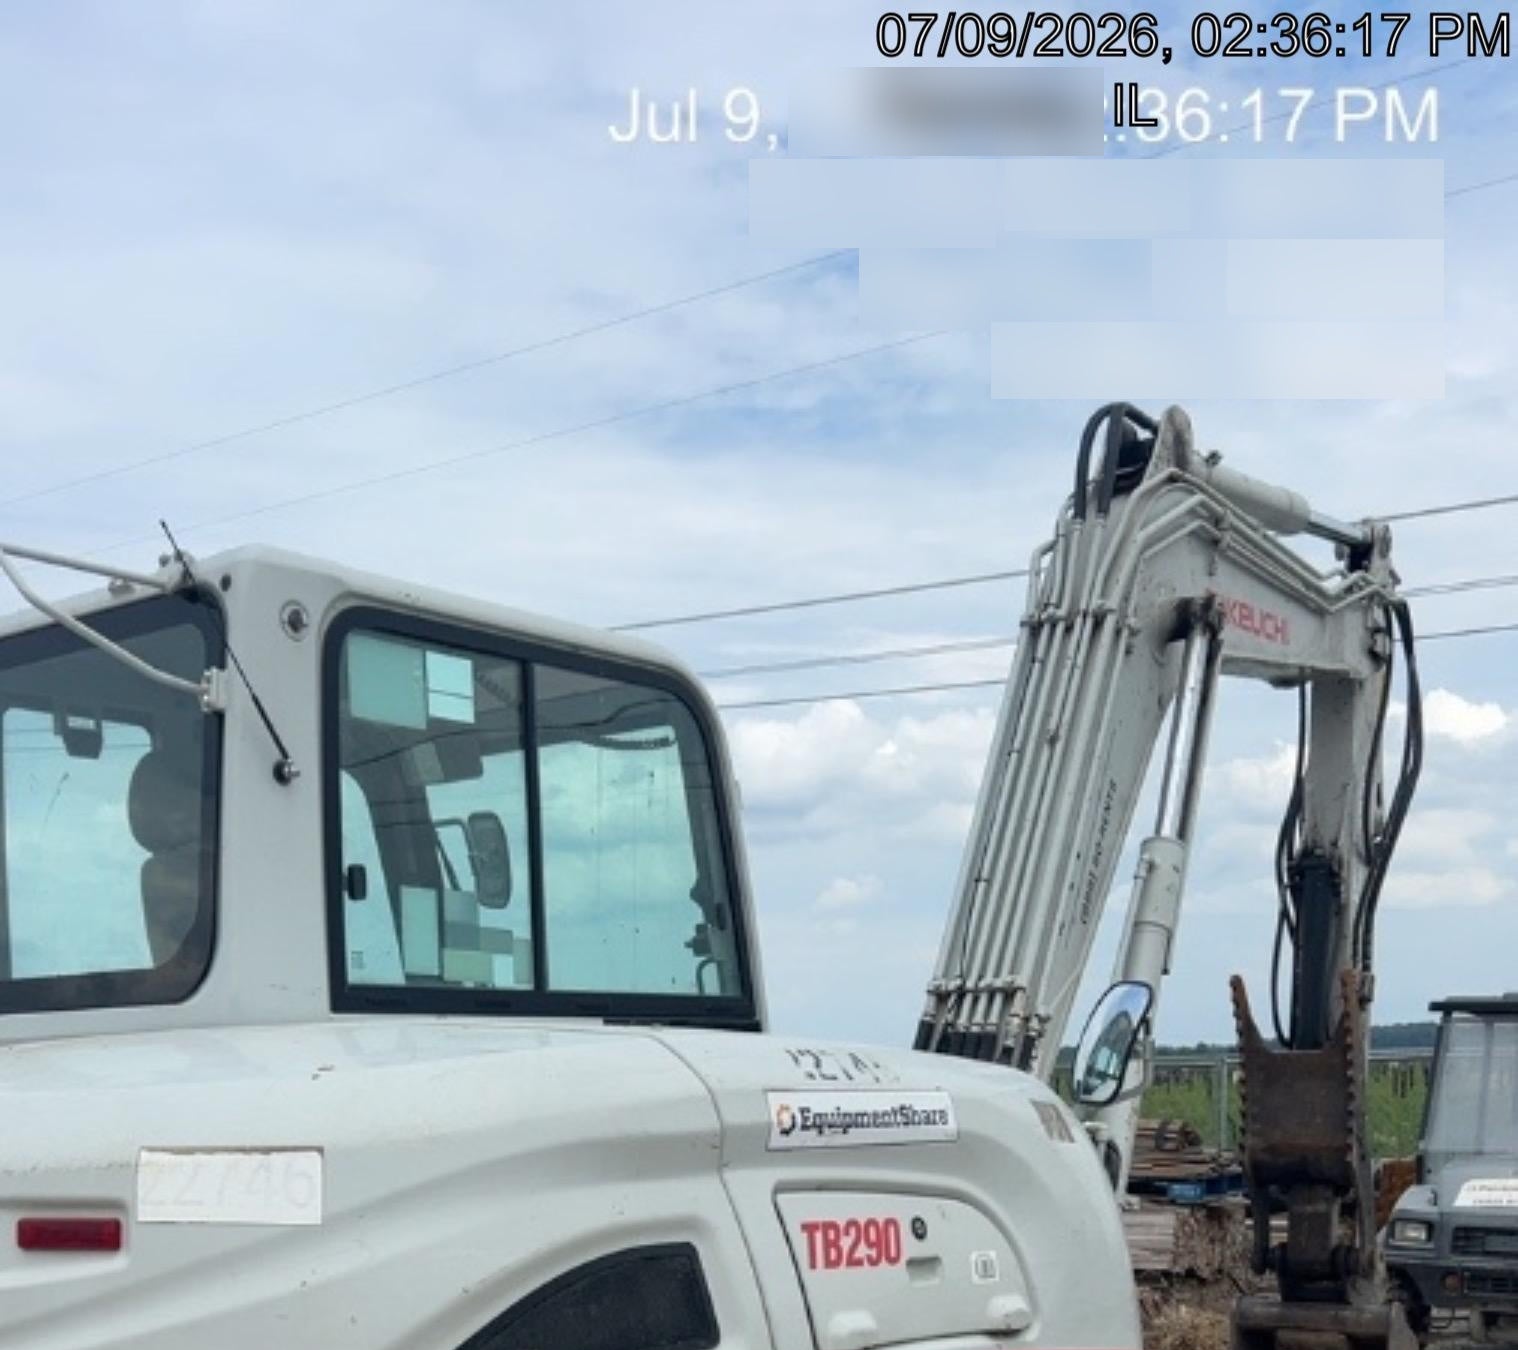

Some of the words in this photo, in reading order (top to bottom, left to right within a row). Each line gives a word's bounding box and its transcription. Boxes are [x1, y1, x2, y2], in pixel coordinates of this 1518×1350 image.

[1212, 594, 1290, 646] KEUCHI
[798, 1105, 949, 1136] EquipmentShare
[801, 1217, 901, 1270] TB290
